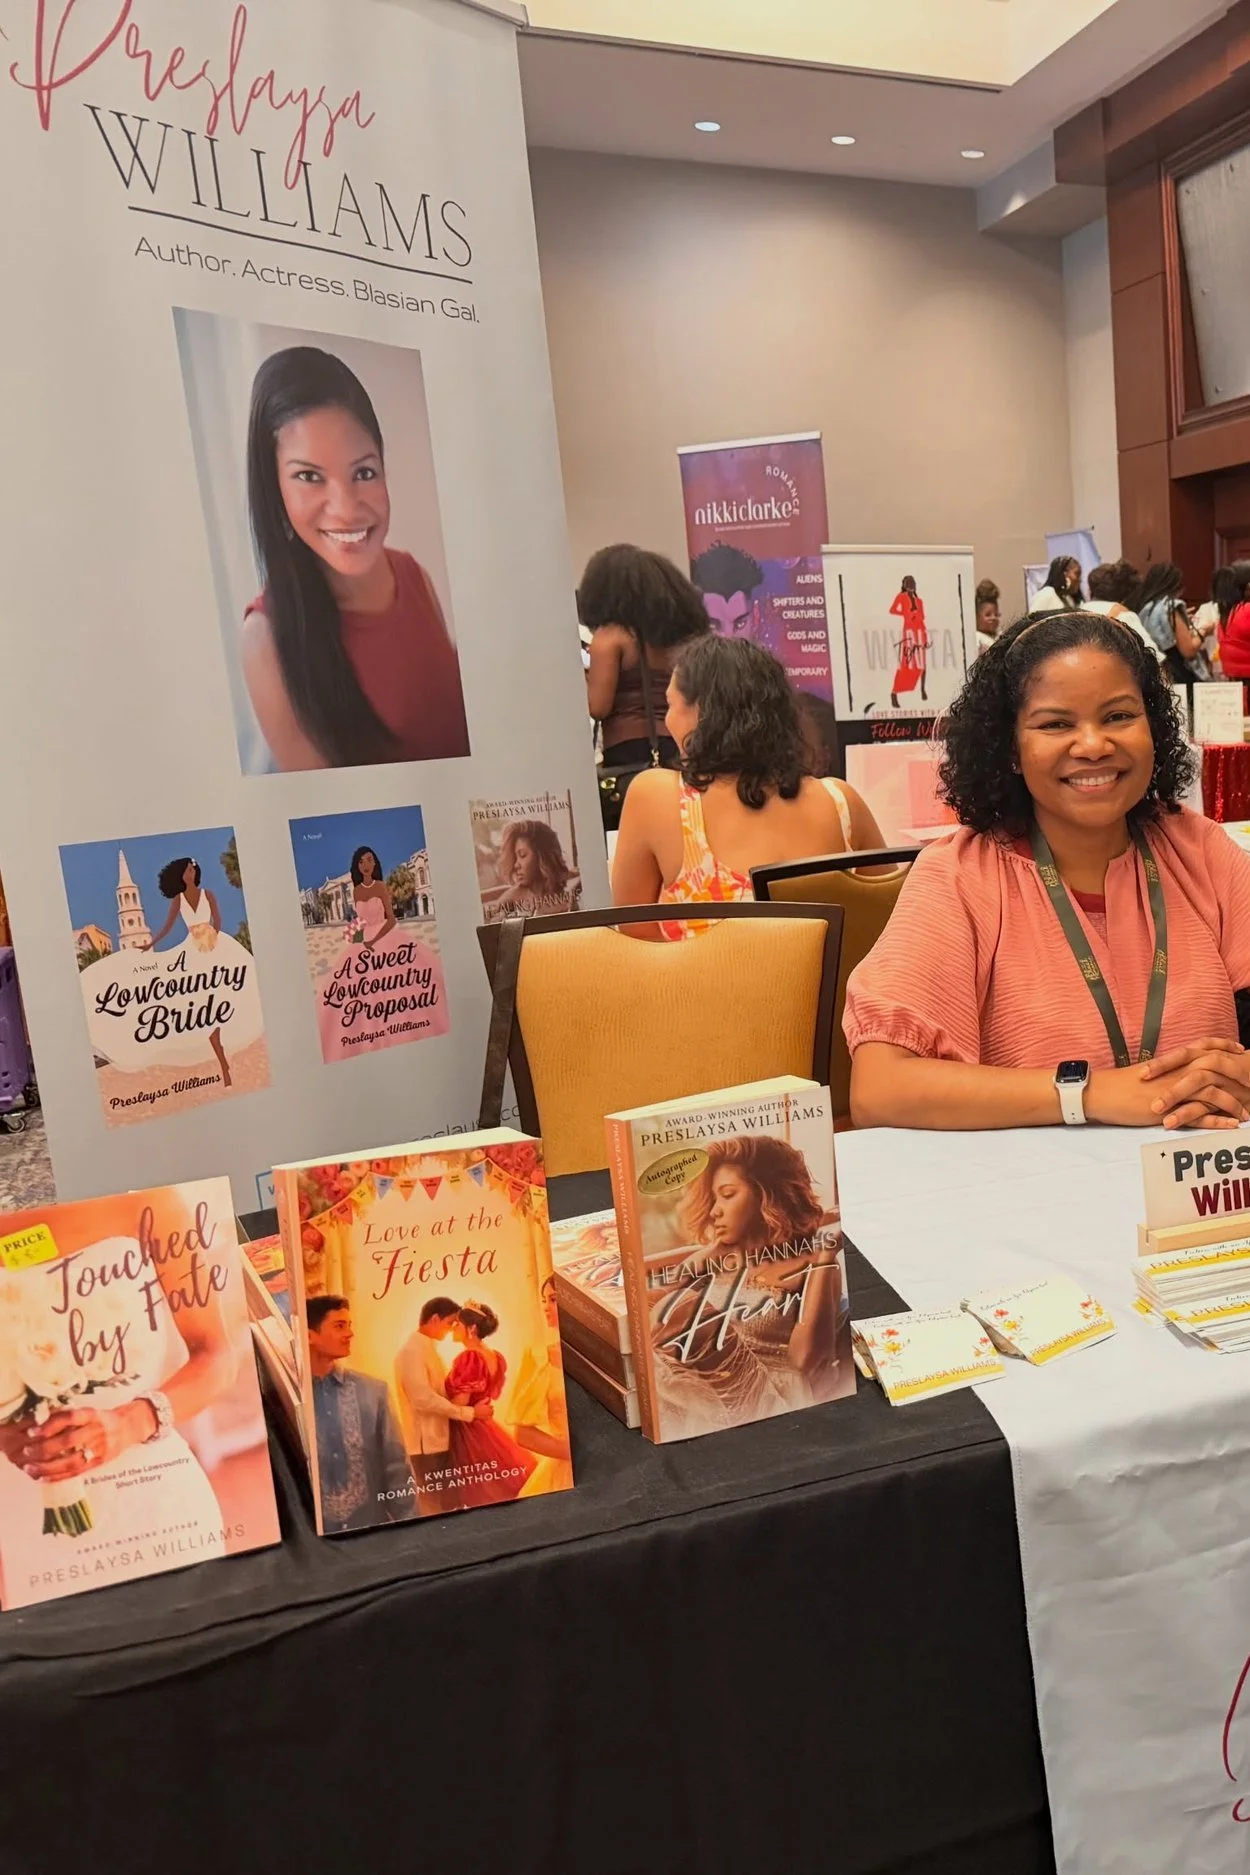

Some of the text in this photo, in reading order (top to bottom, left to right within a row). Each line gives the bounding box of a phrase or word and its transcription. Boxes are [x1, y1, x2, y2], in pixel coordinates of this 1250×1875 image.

[0, 0, 375, 190] Preslaysa
[83, 103, 473, 268] WILLIAMS
[135, 236, 481, 325] Author. Actress. Blasian Gal.
[765, 465, 800, 515] ROMANCE
[796, 574, 823, 584] ALIENS
[772, 596, 824, 607] SHIFTERS AND
[782, 610, 825, 619] CREATURES
[787, 630, 826, 640] GODS AND
[801, 644, 827, 653] MAGIC
[785, 667, 828, 676] EMPORARY
[871, 722, 912, 740] Follow
[473, 801, 572, 821] PRESLAYSA WILLIAMS
[140, 962, 158, 973] Novel
[167, 950, 187, 972] A
[333, 942, 417, 979] A Sweet
[95, 965, 248, 1017] Lowcountry
[323, 968, 433, 1009] Lowcountry
[134, 994, 235, 1043] Bride
[341, 984, 438, 1028] Proposal
[341, 1019, 431, 1047] Preslaysa Williams
[109, 1073, 222, 1110] Preslaysa Williams
[640, 1106, 825, 1147] PRESLAYSA WILLIAMS
[665, 1099, 799, 1128] AWARD-WINNING AUTHOR
[645, 1151, 699, 1184] Autographed
[664, 1171, 686, 1187] Copy
[4, 1231, 48, 1253] PRICE
[363, 1206, 503, 1246] Love at the
[46, 1201, 218, 1315] Touched
[372, 1245, 499, 1301] Fiesta
[652, 1253, 740, 1285] HEALING
[138, 1252, 229, 1331] Fate
[662, 1263, 840, 1363] Heart
[69, 1308, 131, 1375] by
[893, 1359, 997, 1390] PRESLAYSA WILLIAMS
[115, 1474, 163, 1489] Short Story
[143, 1458, 190, 1472] Lowcountry
[406, 1460, 498, 1485] A KWENTITAS
[377, 1466, 529, 1501] ROMANCE ANTHOLOGY
[29, 1524, 247, 1588] PRESLAYSA WILLIAMS
